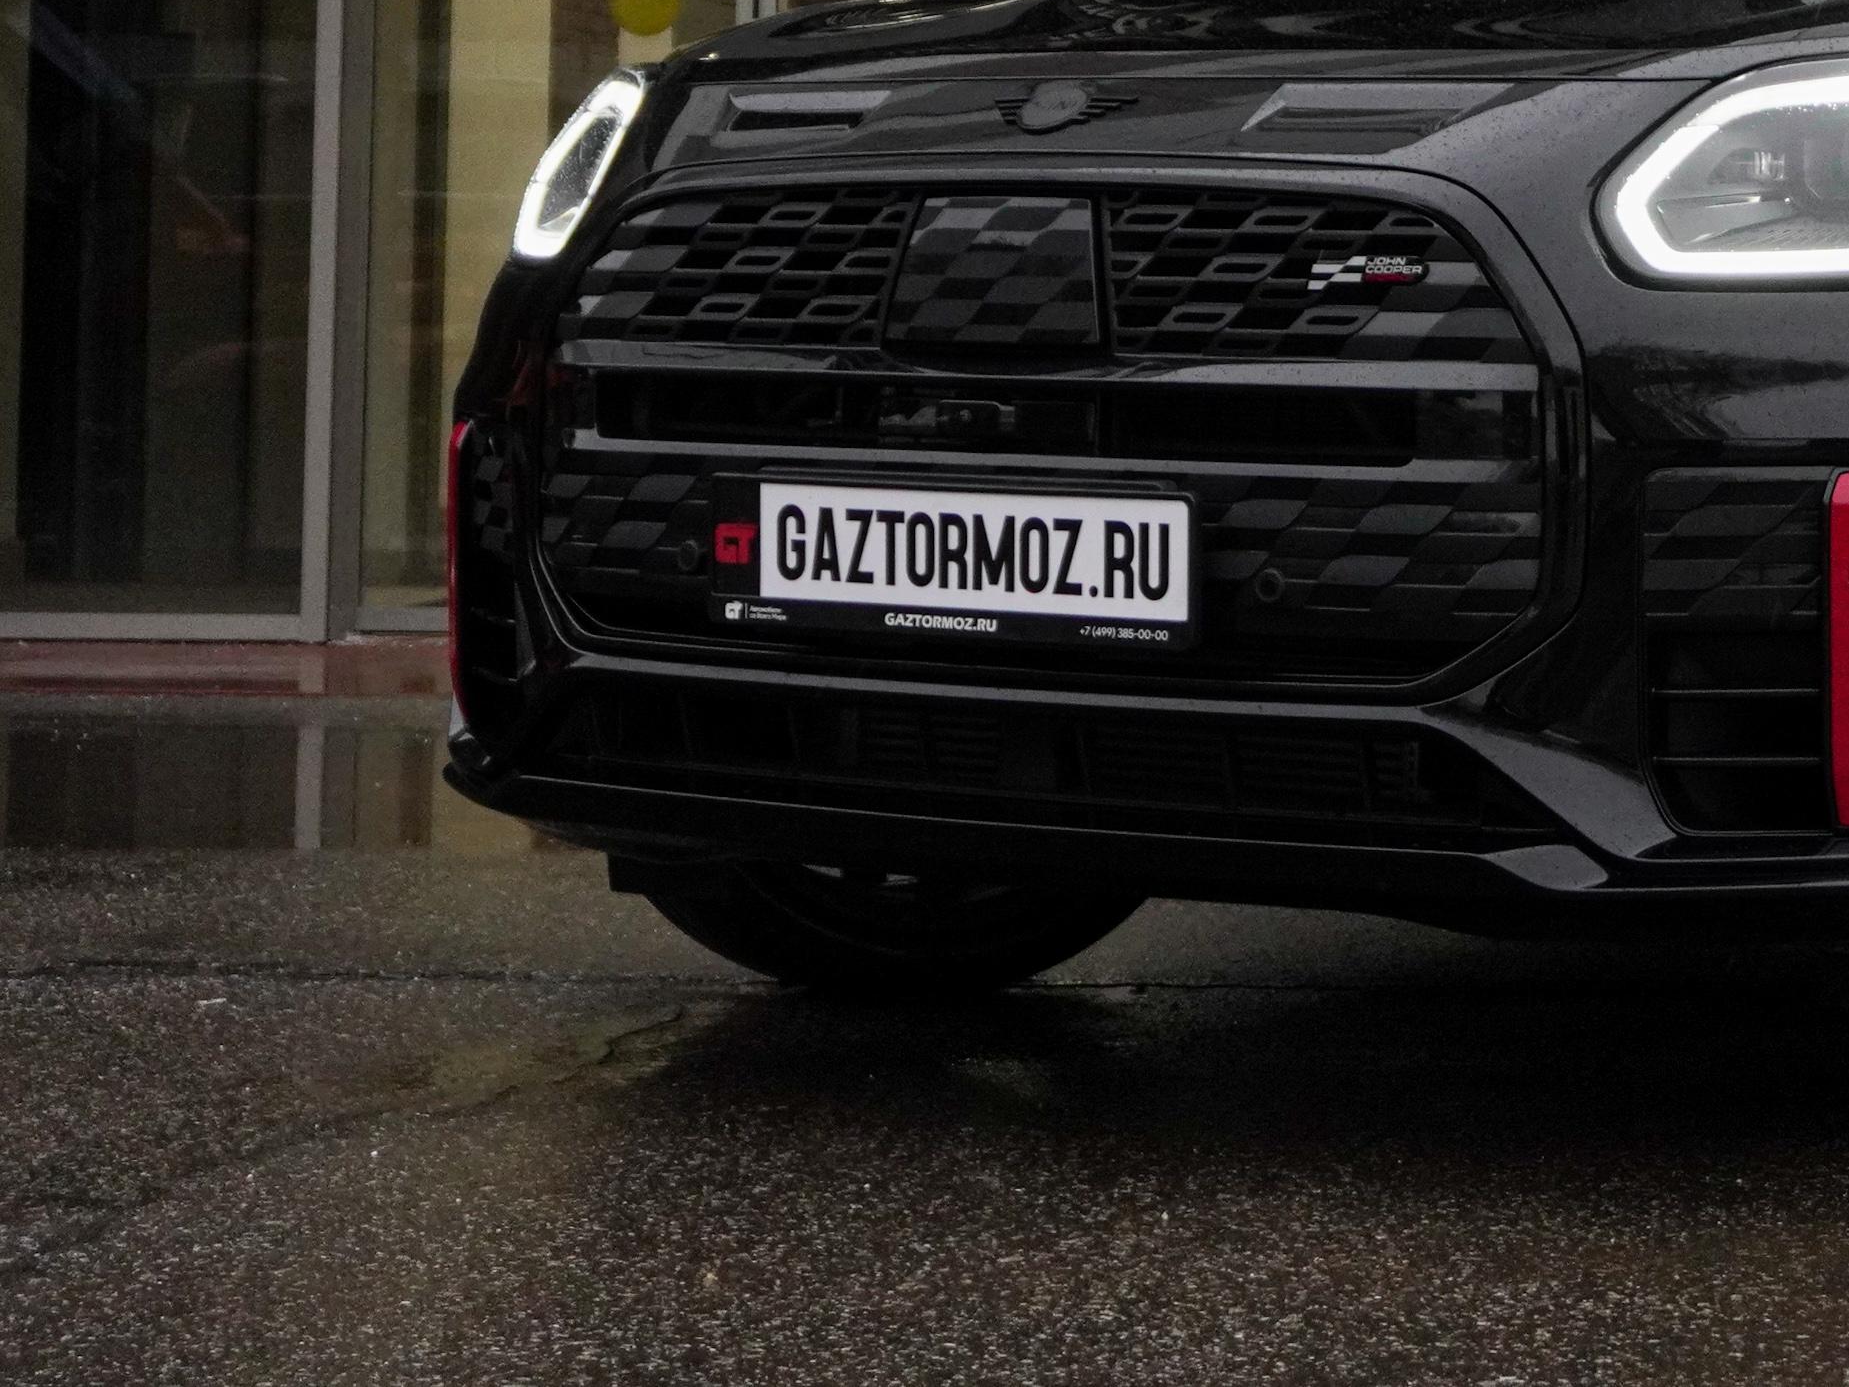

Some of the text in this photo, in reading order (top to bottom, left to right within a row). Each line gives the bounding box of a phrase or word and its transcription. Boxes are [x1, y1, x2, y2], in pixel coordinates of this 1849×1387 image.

[1367, 256, 1406, 266] JOHN
[1365, 265, 1423, 274] COOPER
[776, 504, 1171, 601] GAZTORMOZ.RU
[884, 612, 998, 632] GAZTORMOZ.RU
[1079, 626, 1169, 641] +7 (499) 385-00-00
